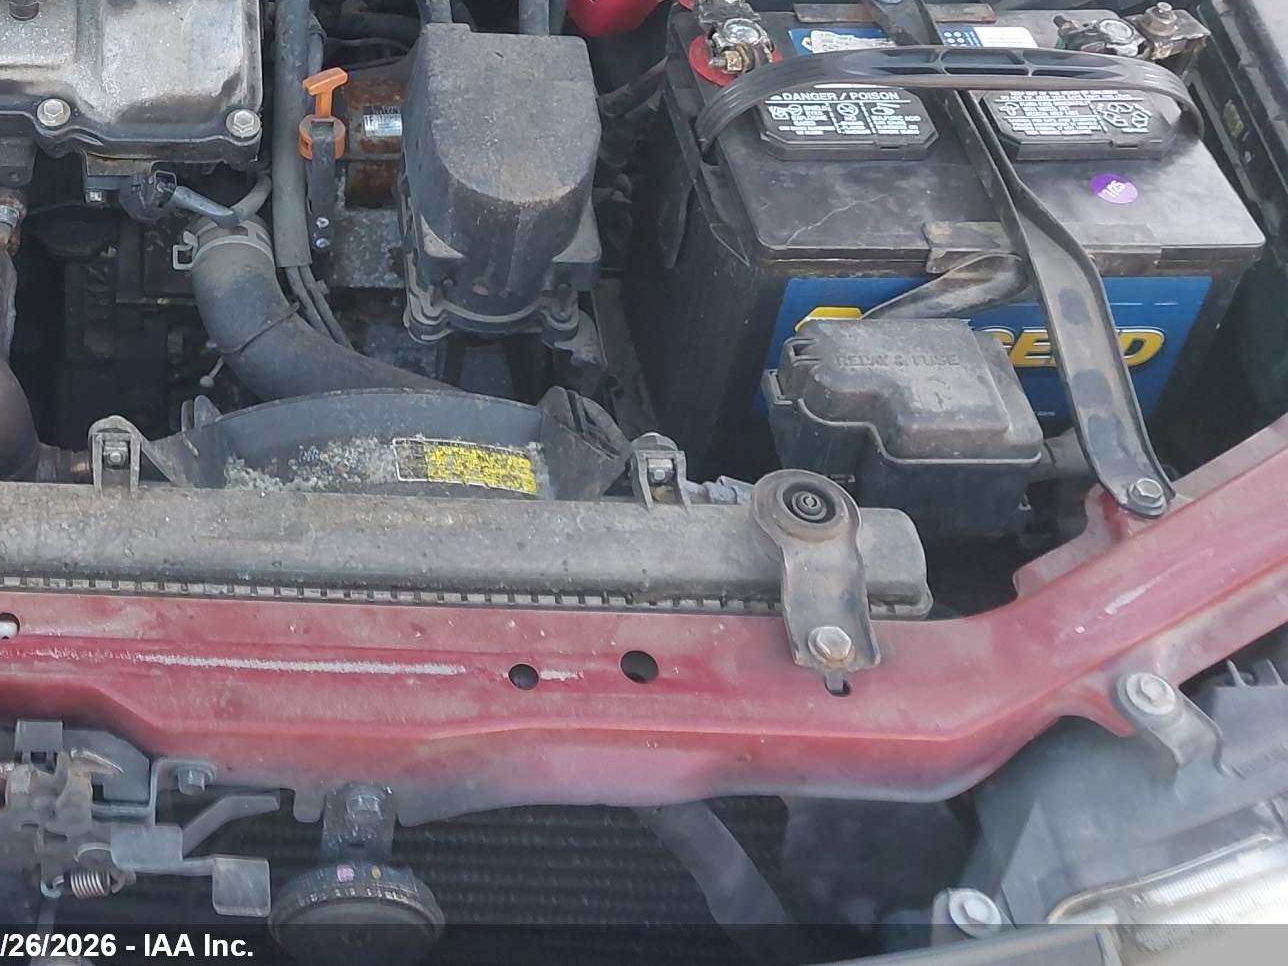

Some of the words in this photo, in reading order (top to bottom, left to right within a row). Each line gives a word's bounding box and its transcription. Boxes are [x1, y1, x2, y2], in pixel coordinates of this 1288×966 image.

[781, 91, 838, 101] DANGER
[849, 90, 901, 101] POISON
[836, 353, 889, 367] RELAY
[894, 354, 909, 367] &
[912, 353, 961, 367] FUSE
